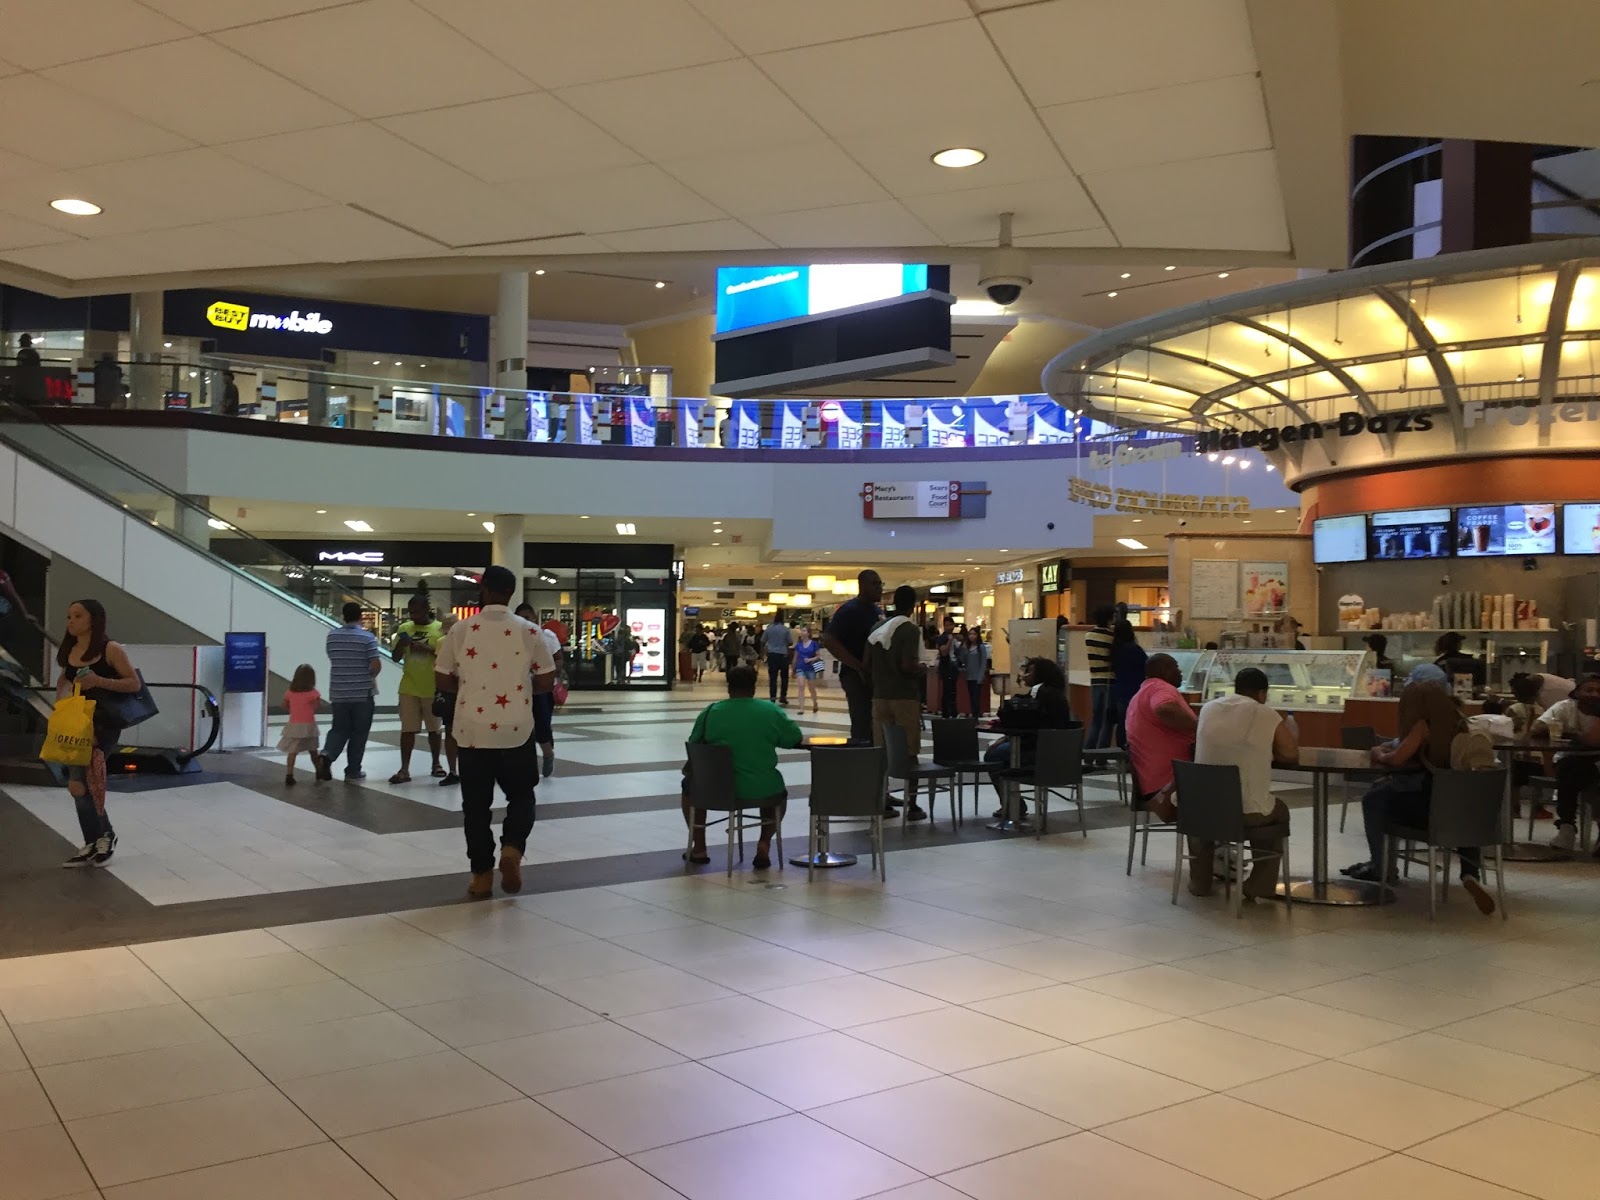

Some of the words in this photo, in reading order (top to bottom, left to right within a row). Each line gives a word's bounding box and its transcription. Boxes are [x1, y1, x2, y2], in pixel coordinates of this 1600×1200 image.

[214, 307, 247, 318] BEST
[214, 315, 242, 325] BUY
[1042, 565, 1059, 584] KAY
